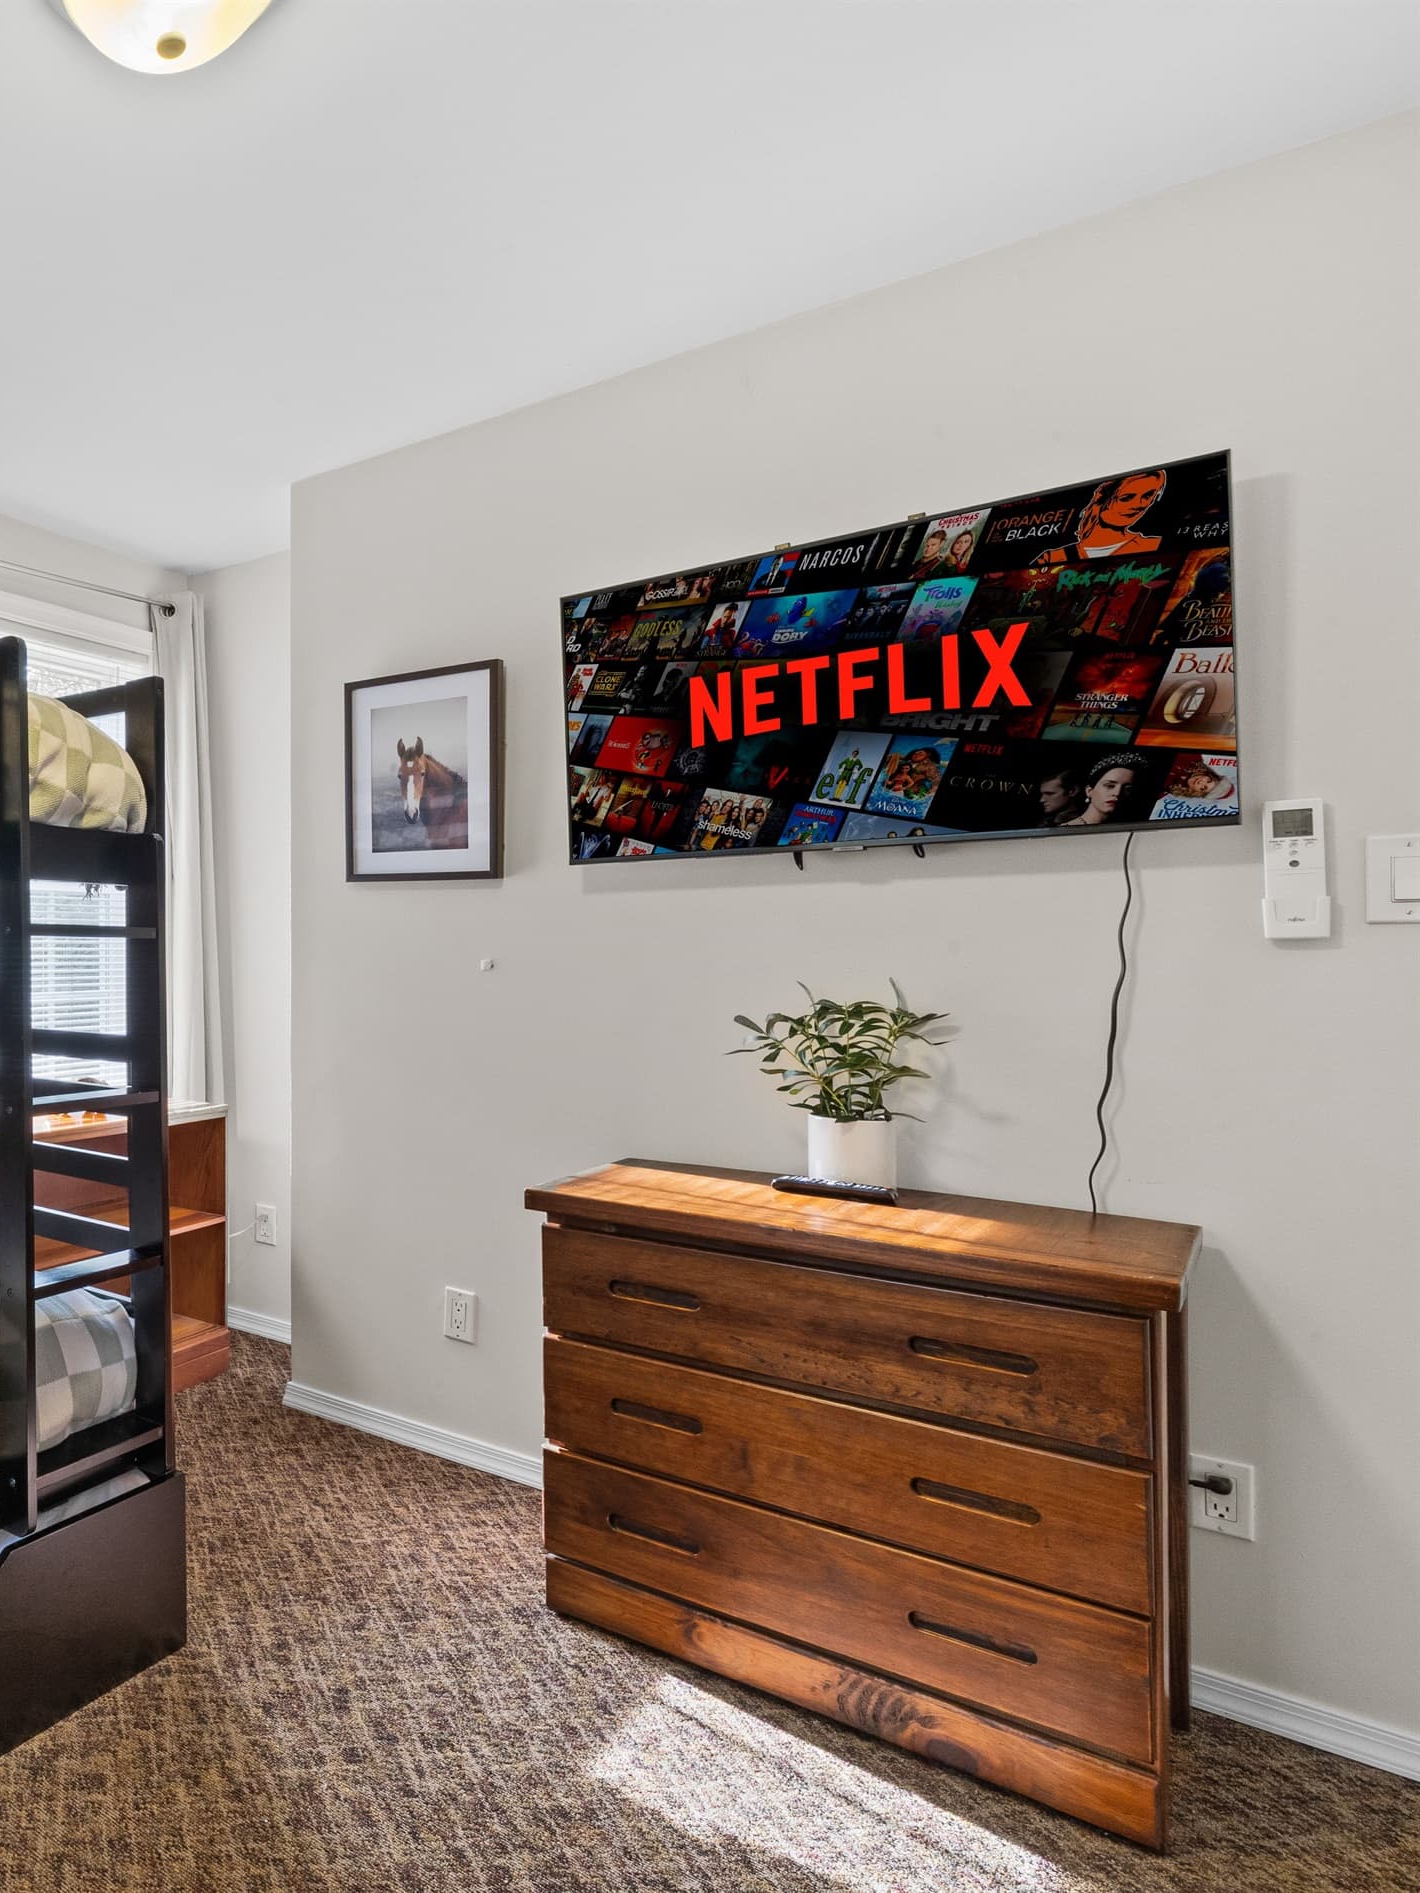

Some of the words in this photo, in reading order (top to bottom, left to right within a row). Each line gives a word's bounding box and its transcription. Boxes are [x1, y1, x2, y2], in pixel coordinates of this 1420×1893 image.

[938, 512, 980, 526] CHRISTMAS
[996, 509, 1067, 530] ORANGE
[1005, 522, 1061, 542] BLACK
[1193, 528, 1228, 539] WHY
[798, 544, 864, 571] NARCOS
[634, 619, 682, 638] GODLESS
[771, 631, 808, 642] DORY
[595, 675, 622, 683] CLONE
[690, 622, 1032, 748] NETFLIX
[593, 683, 617, 691] WARS
[1075, 692, 1129, 702] STRANGER
[1079, 700, 1119, 710] THINGS
[963, 743, 1004, 757] NETFLIX
[949, 775, 1034, 796] CROWN
[874, 800, 917, 815] MOANA
[698, 818, 752, 841] shameless
